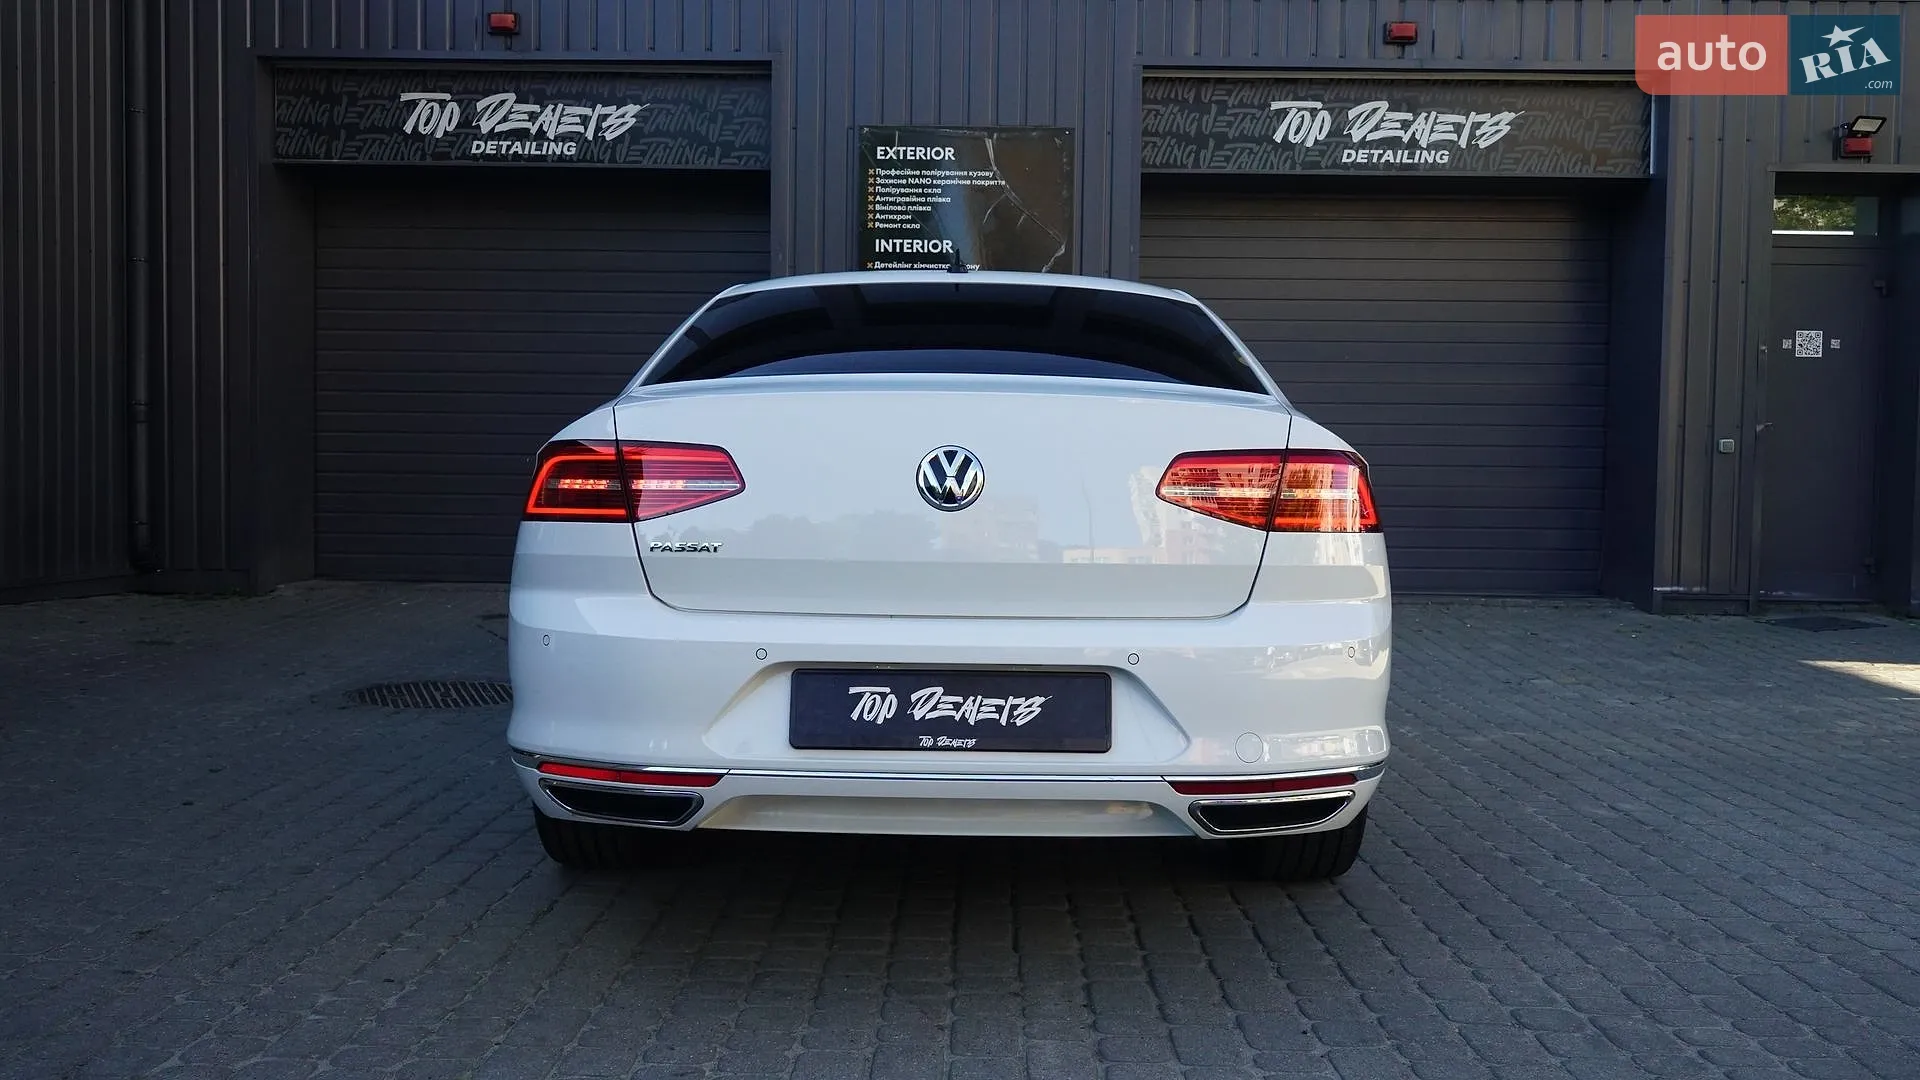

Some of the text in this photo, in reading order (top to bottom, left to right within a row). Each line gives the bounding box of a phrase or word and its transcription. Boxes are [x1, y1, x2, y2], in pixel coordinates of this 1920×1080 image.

[471, 140, 577, 155] DETAILING
[876, 146, 956, 160] EXTERIOR
[1342, 149, 1449, 164] DETAILING
[875, 168, 920, 177] Професійне
[875, 186, 922, 195] Полірування
[875, 213, 912, 221] Антихром
[875, 239, 954, 253] INTERIOR
[874, 261, 912, 270] Детейлінг
[649, 541, 724, 553] PASSAT
